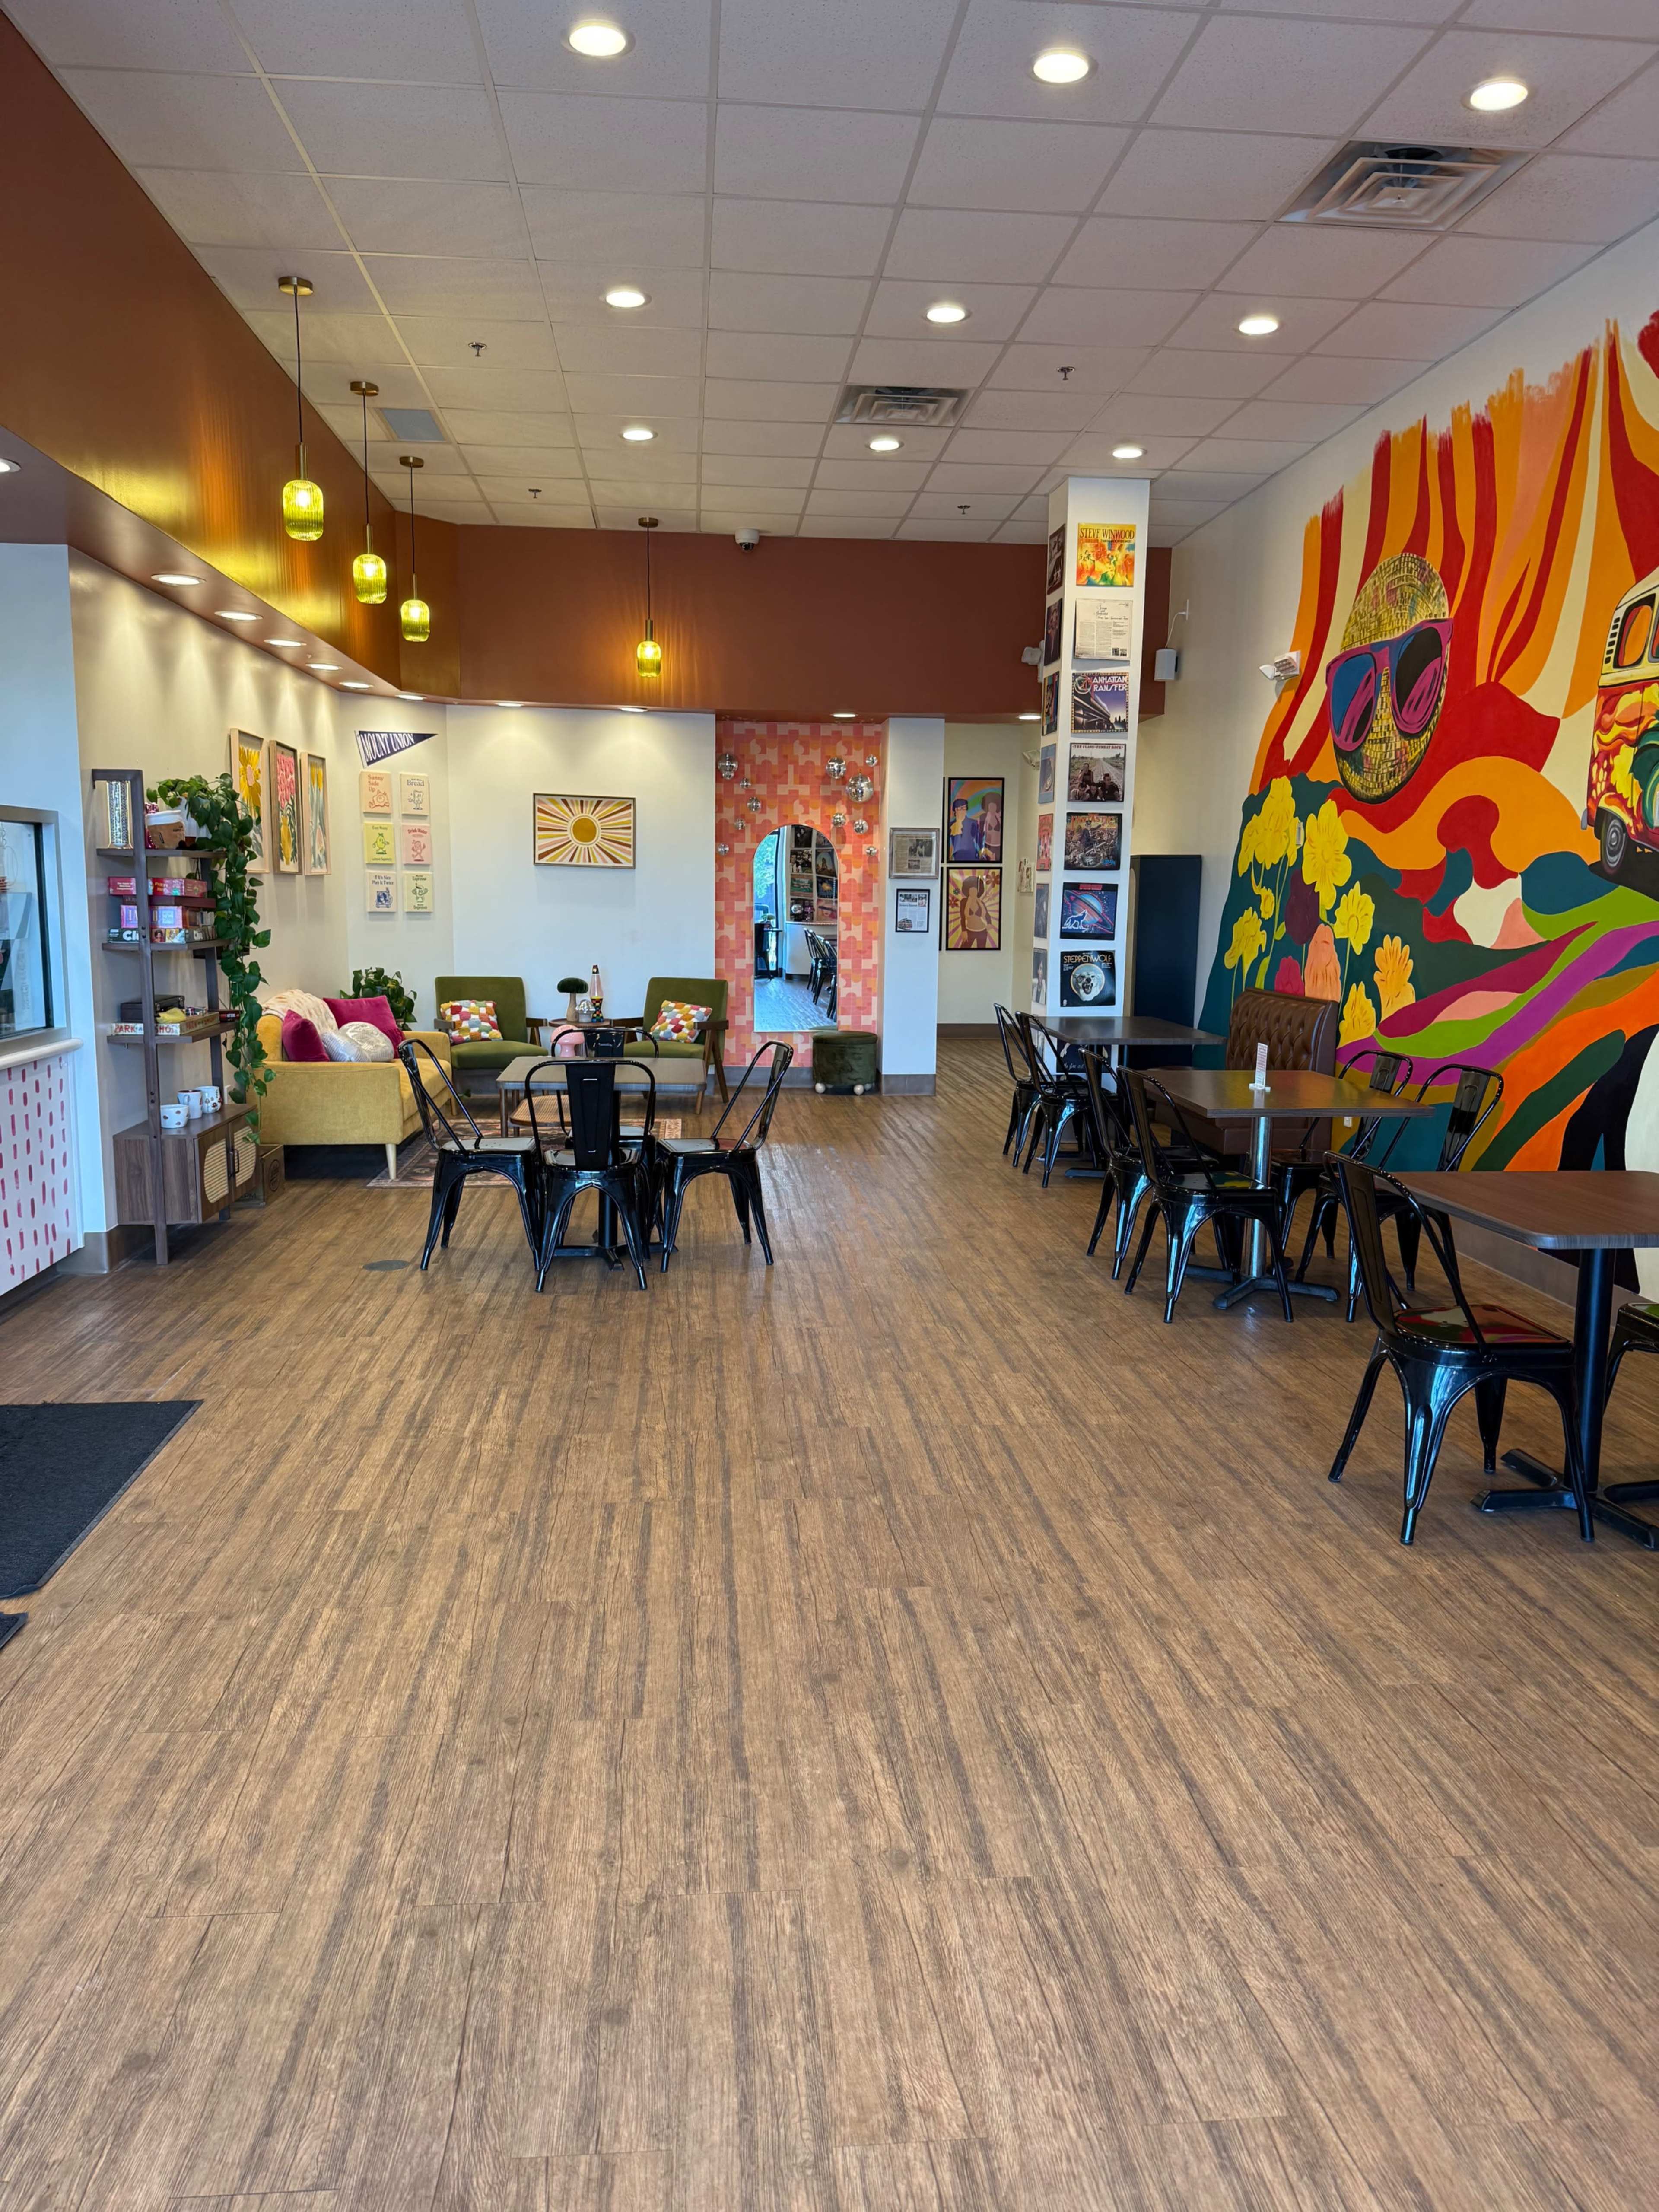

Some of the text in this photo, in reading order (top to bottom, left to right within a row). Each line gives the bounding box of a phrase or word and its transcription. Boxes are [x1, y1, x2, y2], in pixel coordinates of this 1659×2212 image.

[1080, 528, 1135, 540] STEVE WINWOOD
[360, 733, 415, 762] MOUNT UNION
[1063, 954, 1112, 964] STEPPENWOLF
